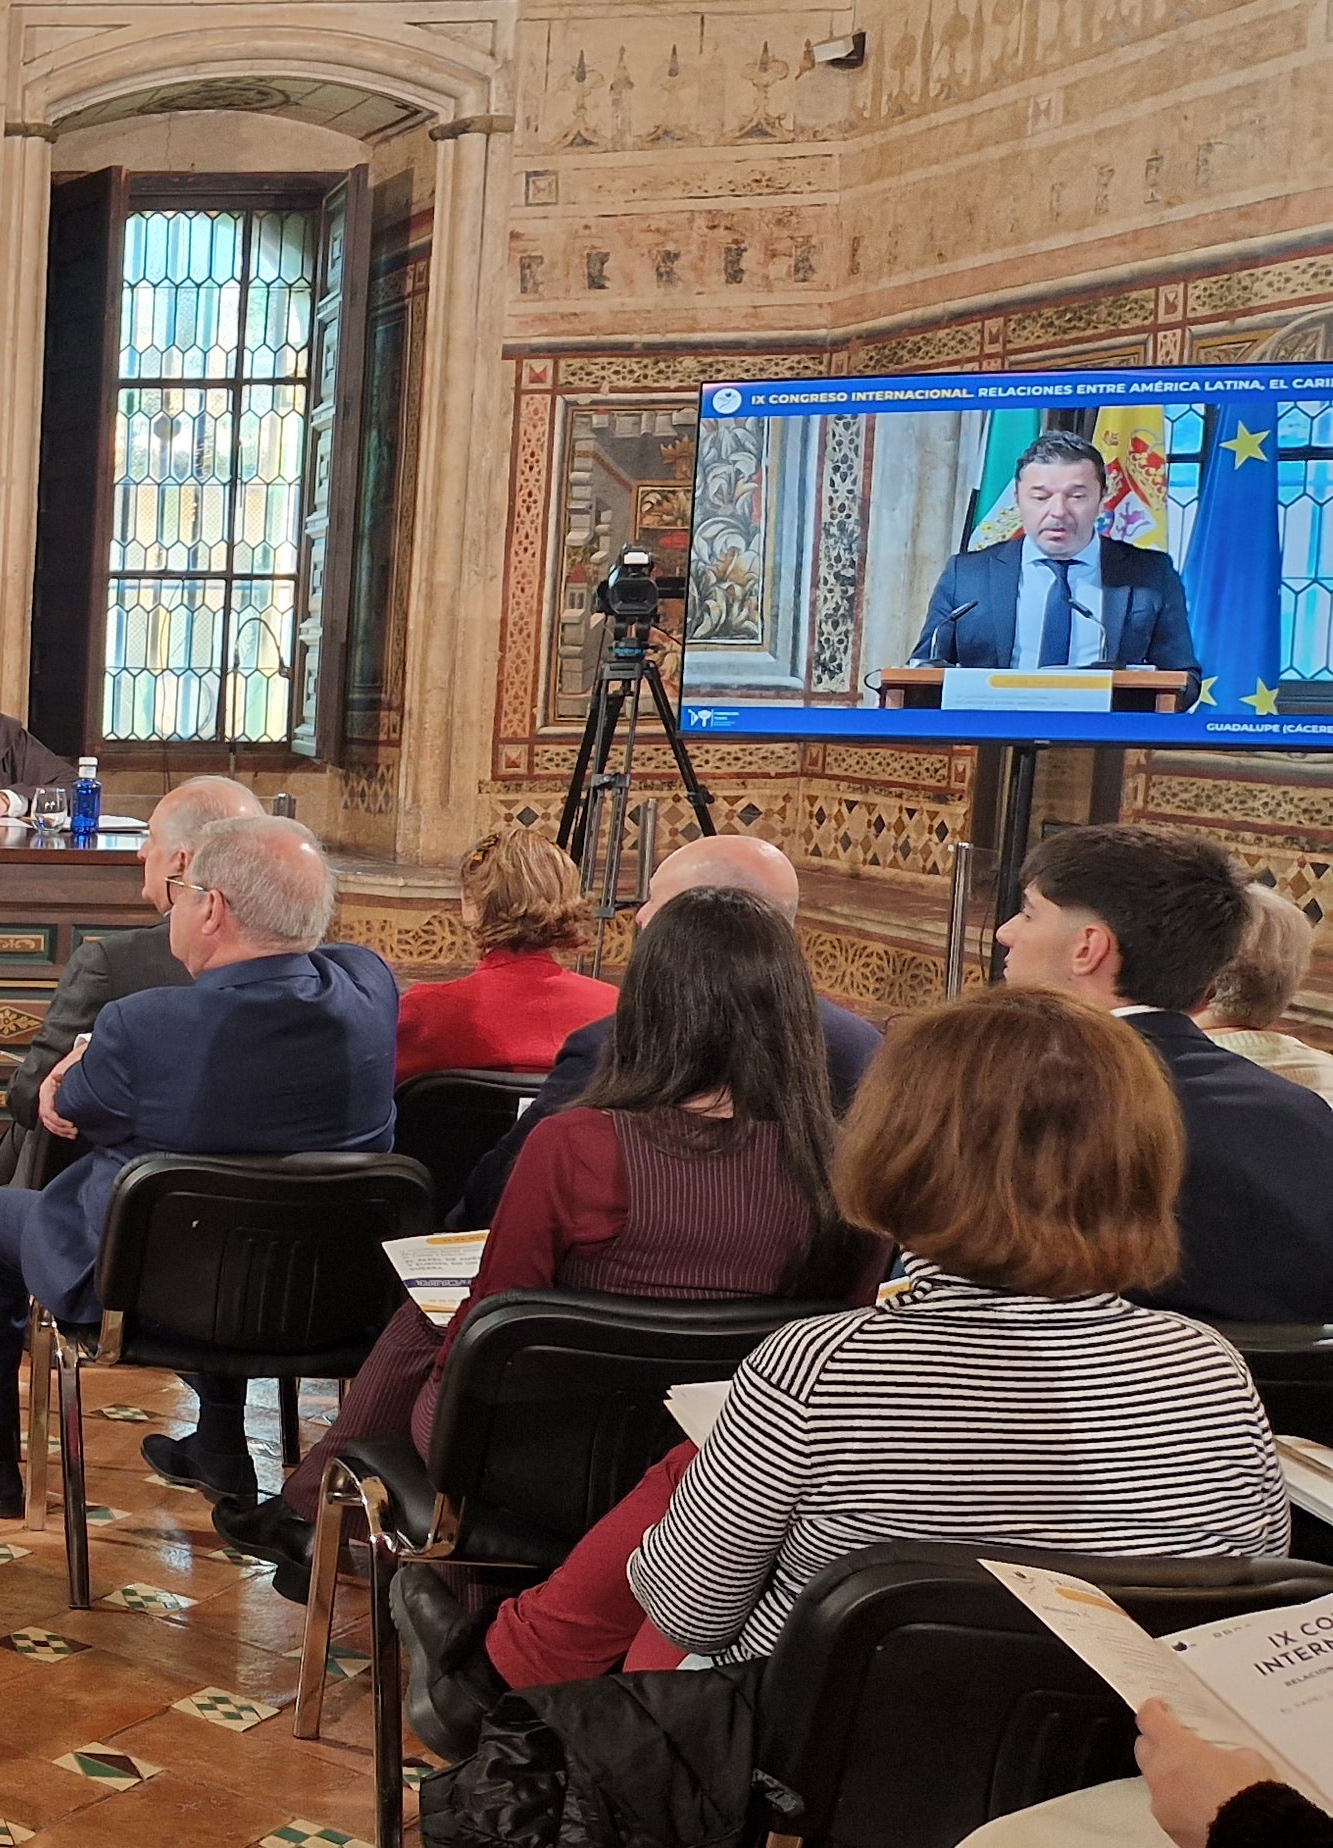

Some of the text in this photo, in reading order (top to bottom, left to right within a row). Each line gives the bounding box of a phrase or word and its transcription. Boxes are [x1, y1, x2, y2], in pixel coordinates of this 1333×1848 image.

[751, 377, 1333, 405] IX CONGRESO INTERNACIONAL. RELACIONES ENTRE AMÉRICA LATINA, EL CARI
[1206, 722, 1280, 733] GUADALUPE
[1268, 1630, 1298, 1648] IX
